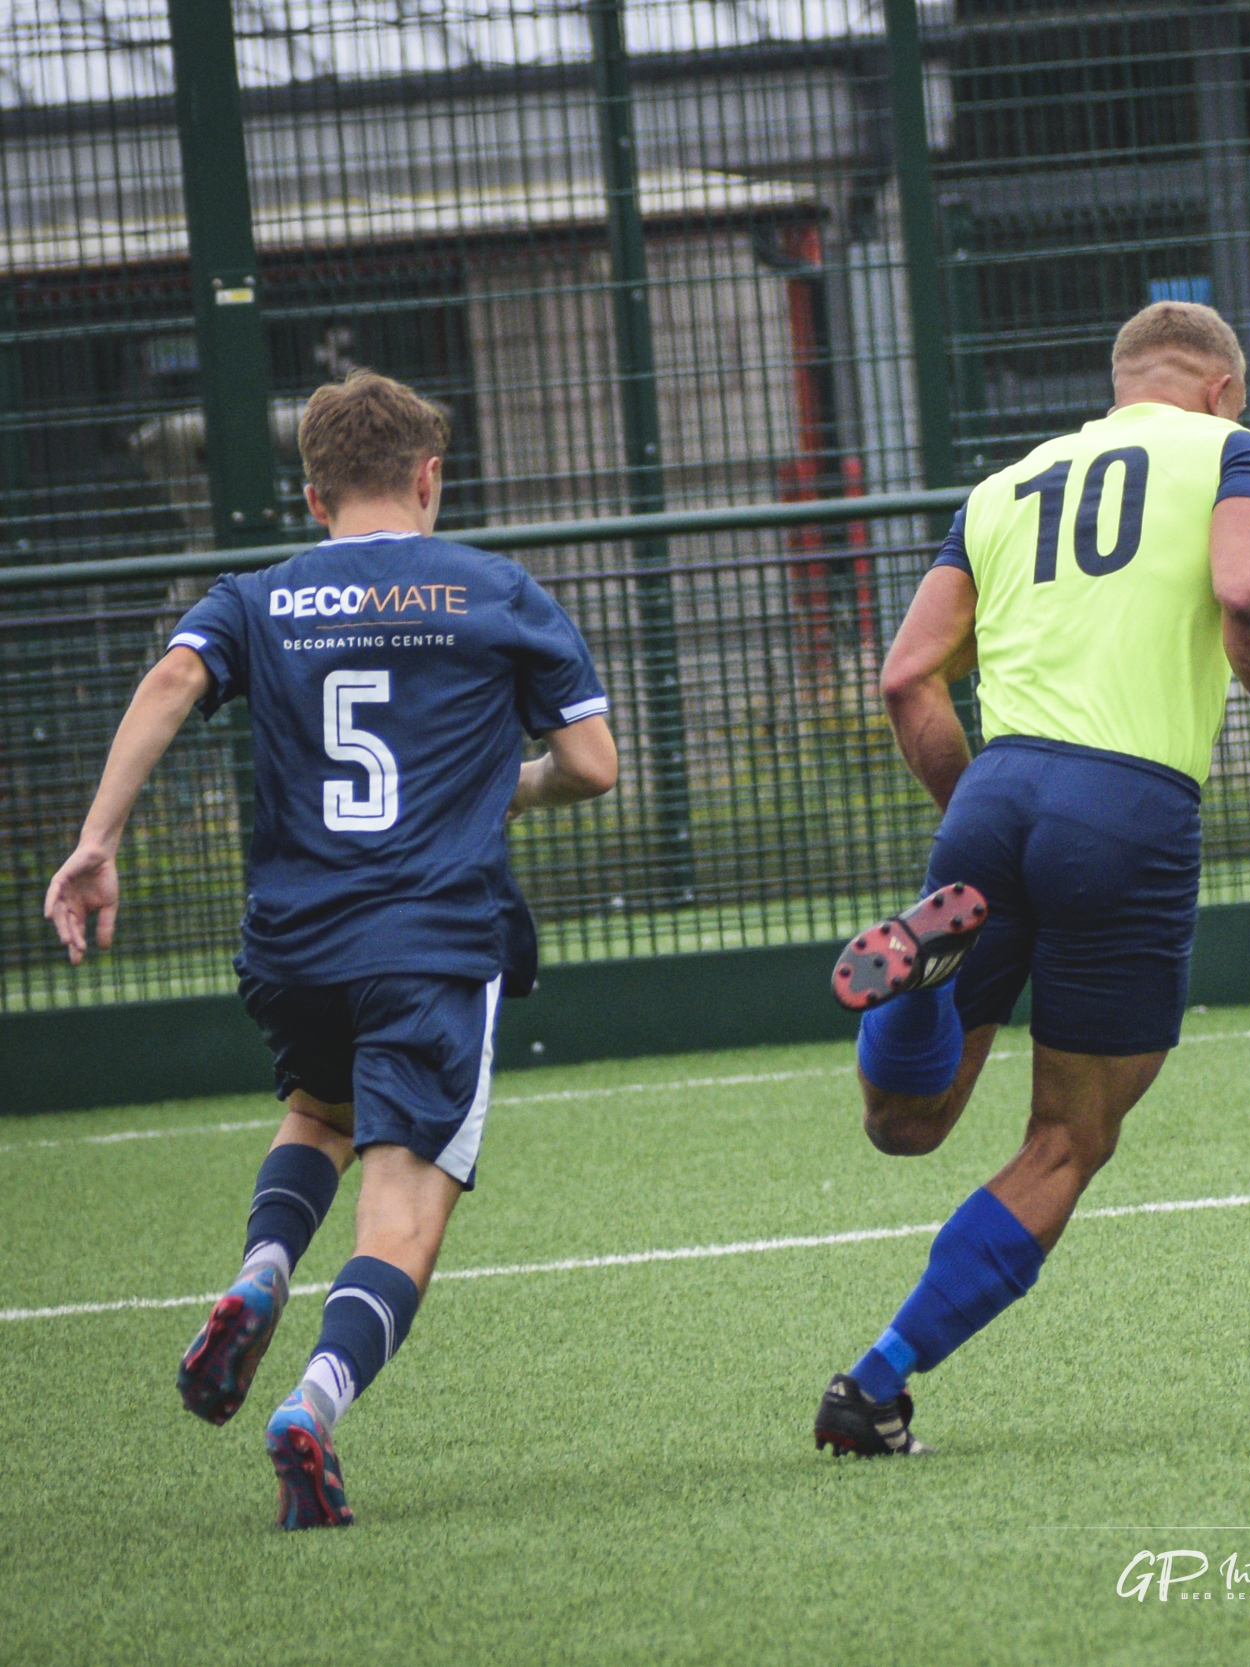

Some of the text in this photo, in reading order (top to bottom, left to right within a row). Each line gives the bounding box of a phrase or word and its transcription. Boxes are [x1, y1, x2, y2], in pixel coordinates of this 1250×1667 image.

[1014, 445, 1149, 585] 10
[269, 584, 468, 618] DECOMATE
[283, 633, 455, 651] DECORATING CENTRE
[323, 670, 398, 832] 5
